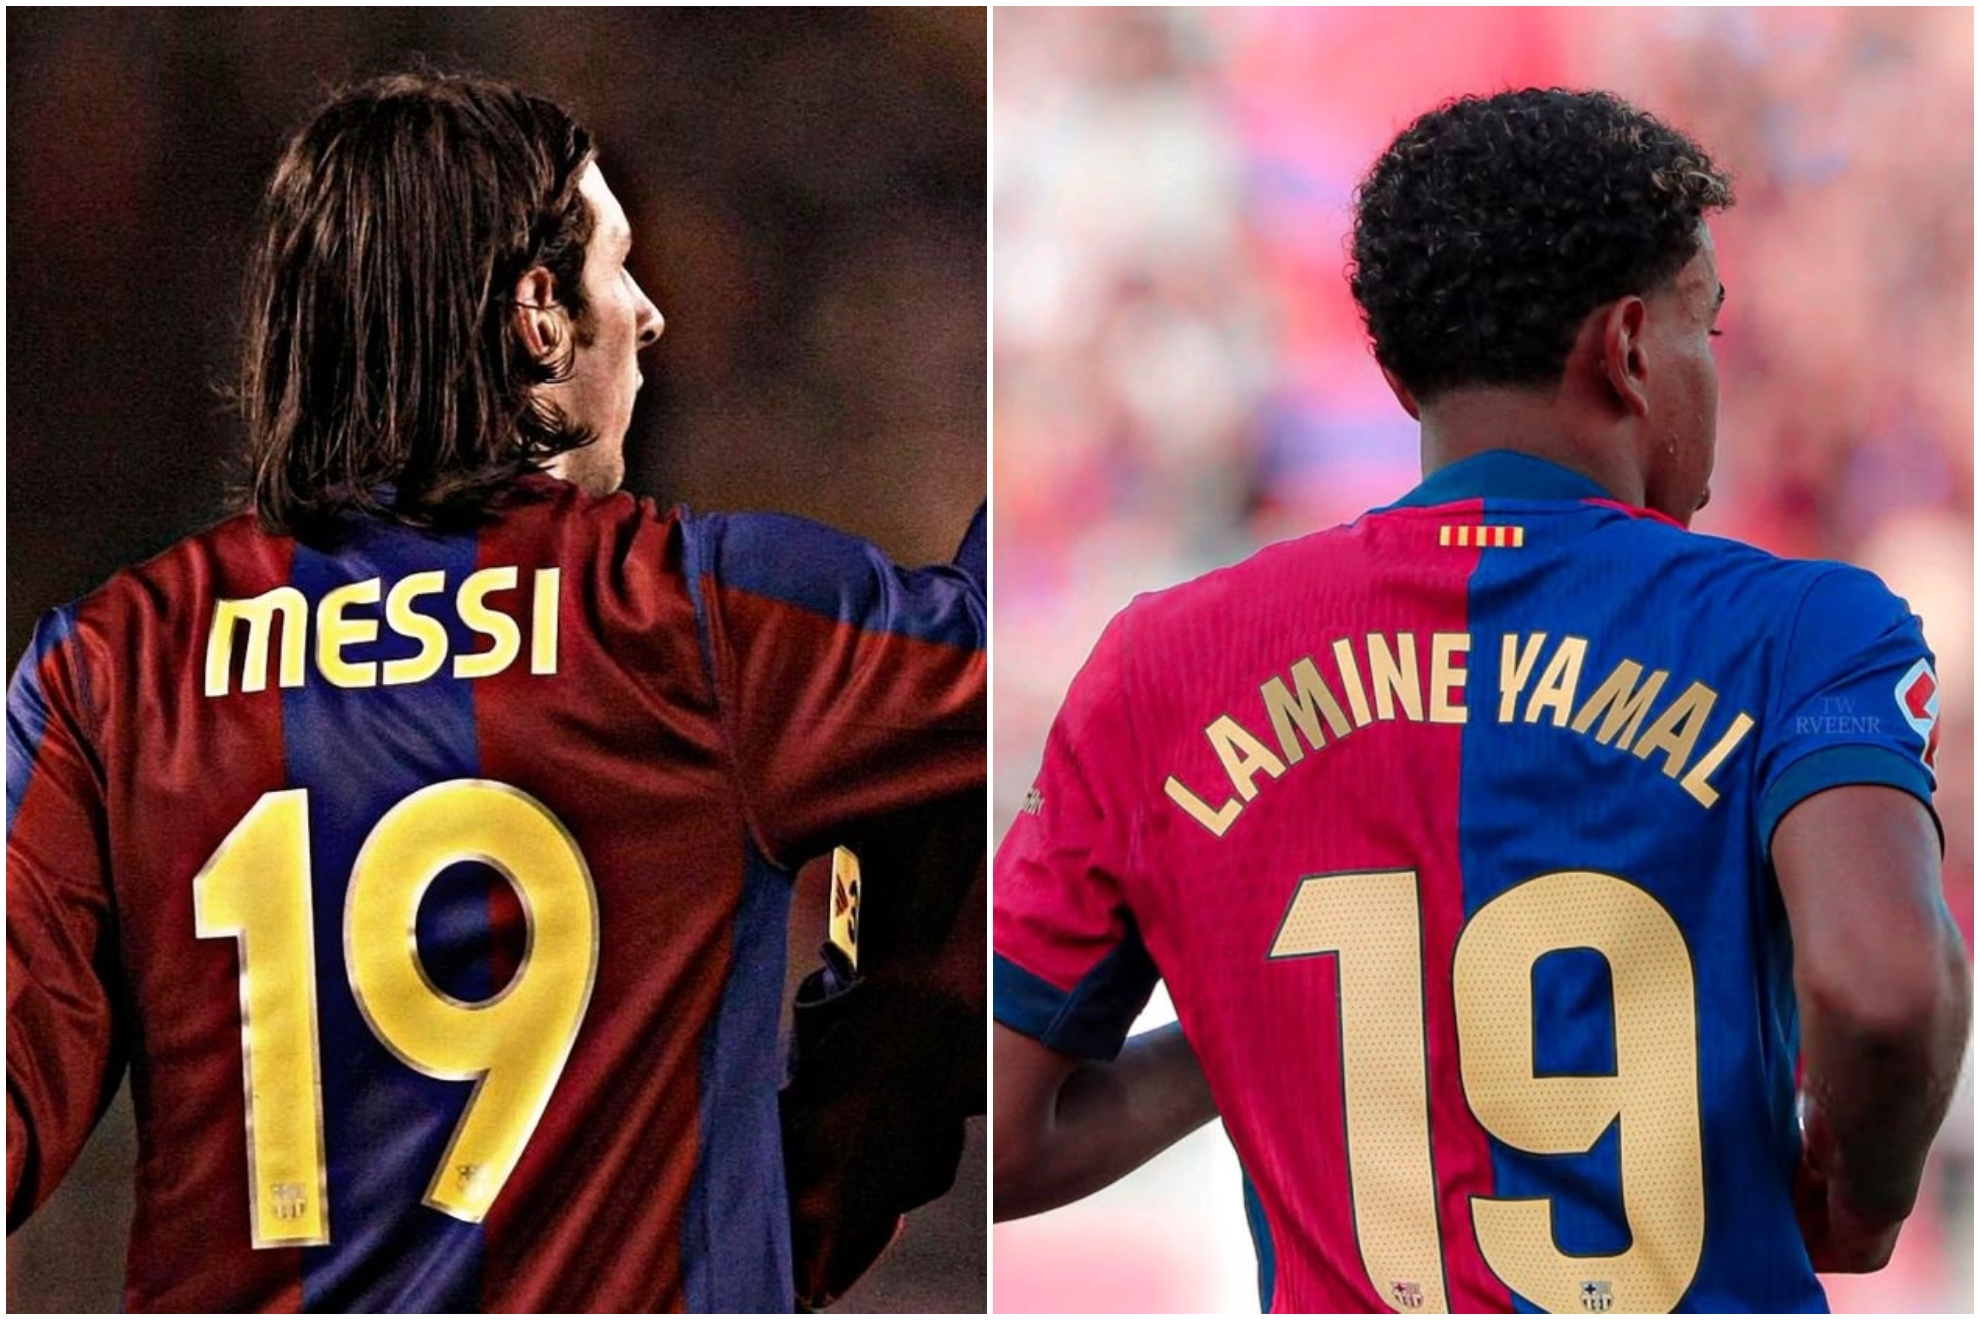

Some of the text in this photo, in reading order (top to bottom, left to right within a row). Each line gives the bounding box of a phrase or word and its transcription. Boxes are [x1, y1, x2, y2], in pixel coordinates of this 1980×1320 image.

[204, 565, 561, 698] MESSI
[1163, 632, 1755, 838] LAMINE YAMAL
[193, 778, 600, 1250] 19
[1267, 870, 1706, 1314] 19
